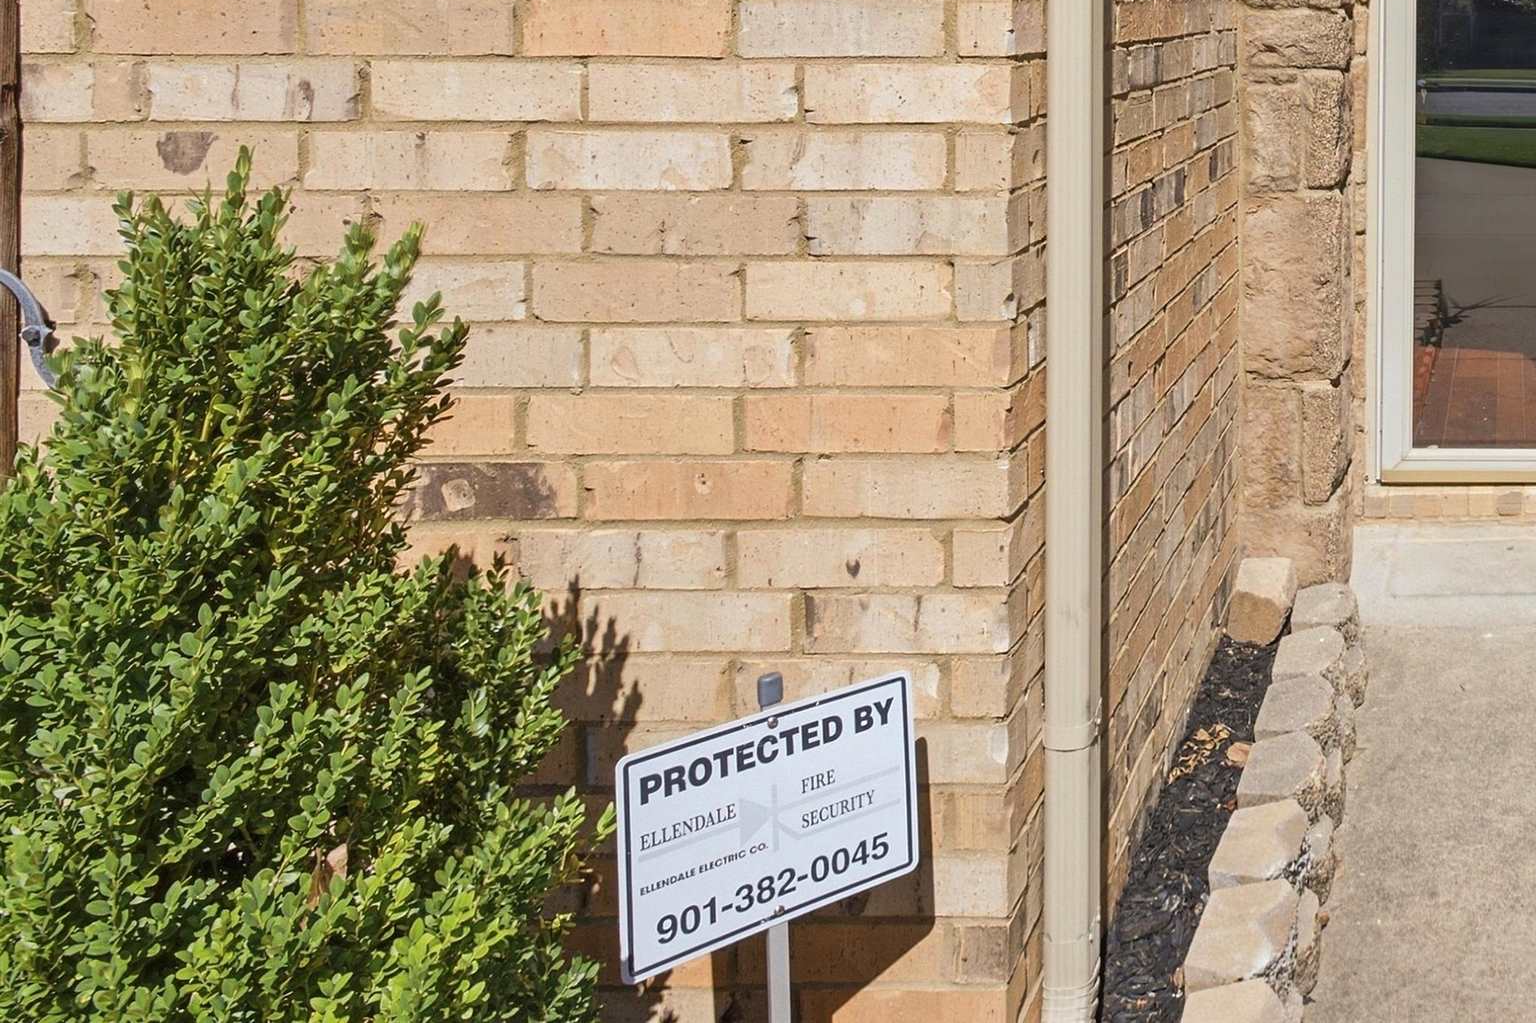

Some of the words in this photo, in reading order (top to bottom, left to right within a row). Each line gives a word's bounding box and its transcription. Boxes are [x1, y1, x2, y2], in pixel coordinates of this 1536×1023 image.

[639, 714, 844, 806] PROTECTED
[854, 697, 895, 735] BY
[800, 768, 837, 795] FIRE
[638, 803, 737, 852] ELLENDALE
[800, 789, 876, 830] SECURITY
[639, 868, 696, 897] ELLENDALE
[698, 849, 746, 875] ELECTRIC
[749, 841, 769, 856] CO.
[656, 831, 890, 945] 901-382-0045
